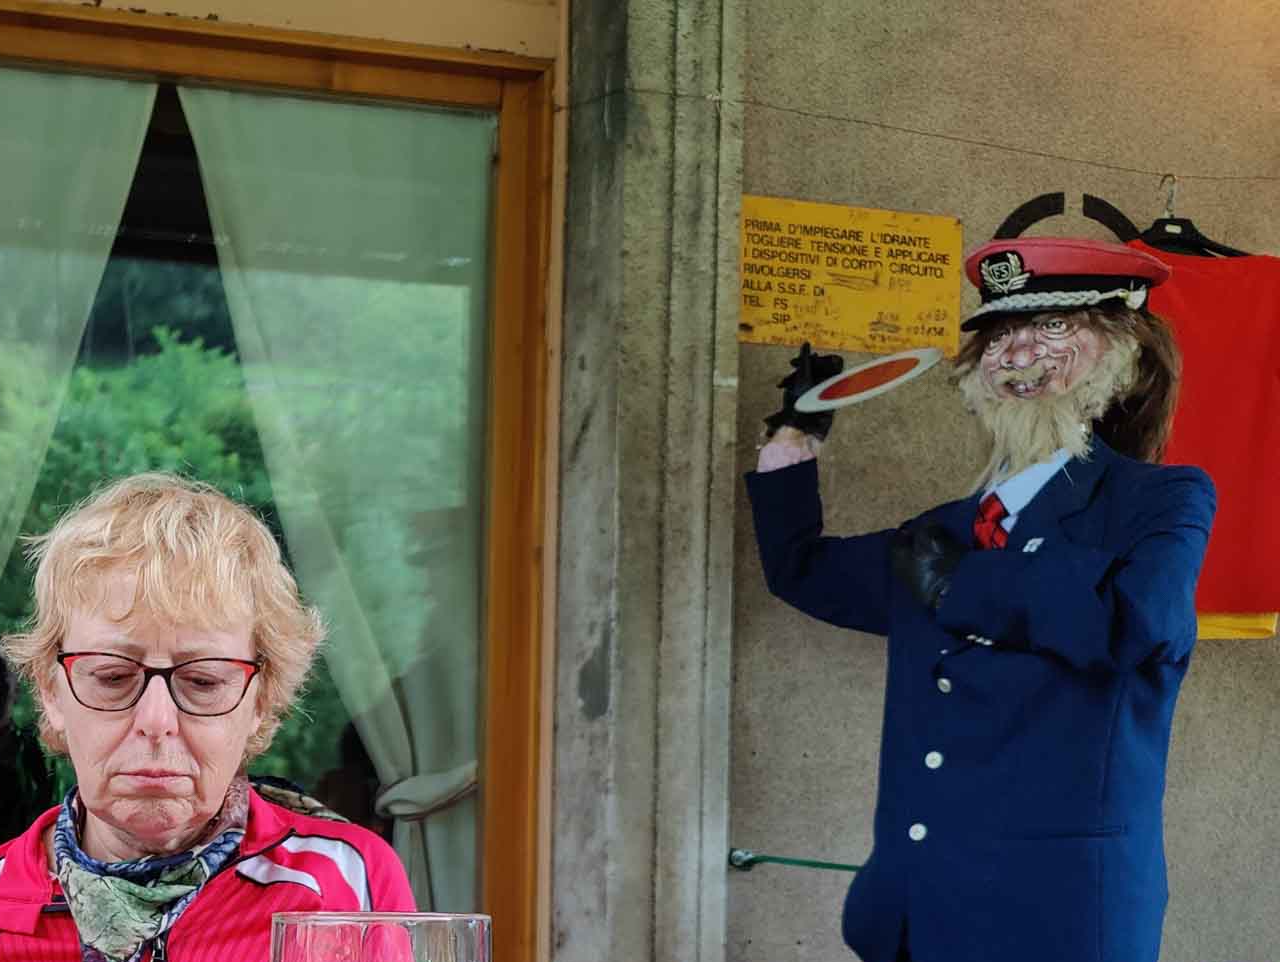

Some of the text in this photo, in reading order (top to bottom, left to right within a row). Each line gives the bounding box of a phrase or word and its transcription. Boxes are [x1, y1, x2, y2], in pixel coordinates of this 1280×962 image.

[744, 218, 930, 249] PRIMA D'IMPIEGARE L'IDRANTE
[746, 233, 950, 266] TOGLIERE TENSIONE E APPLICARE
[752, 248, 820, 265] DISPOSITIVI
[826, 256, 838, 267] DI
[743, 262, 811, 280] RIVOLGERSI
[742, 278, 773, 292] ALLA
[771, 312, 791, 325] SIP
